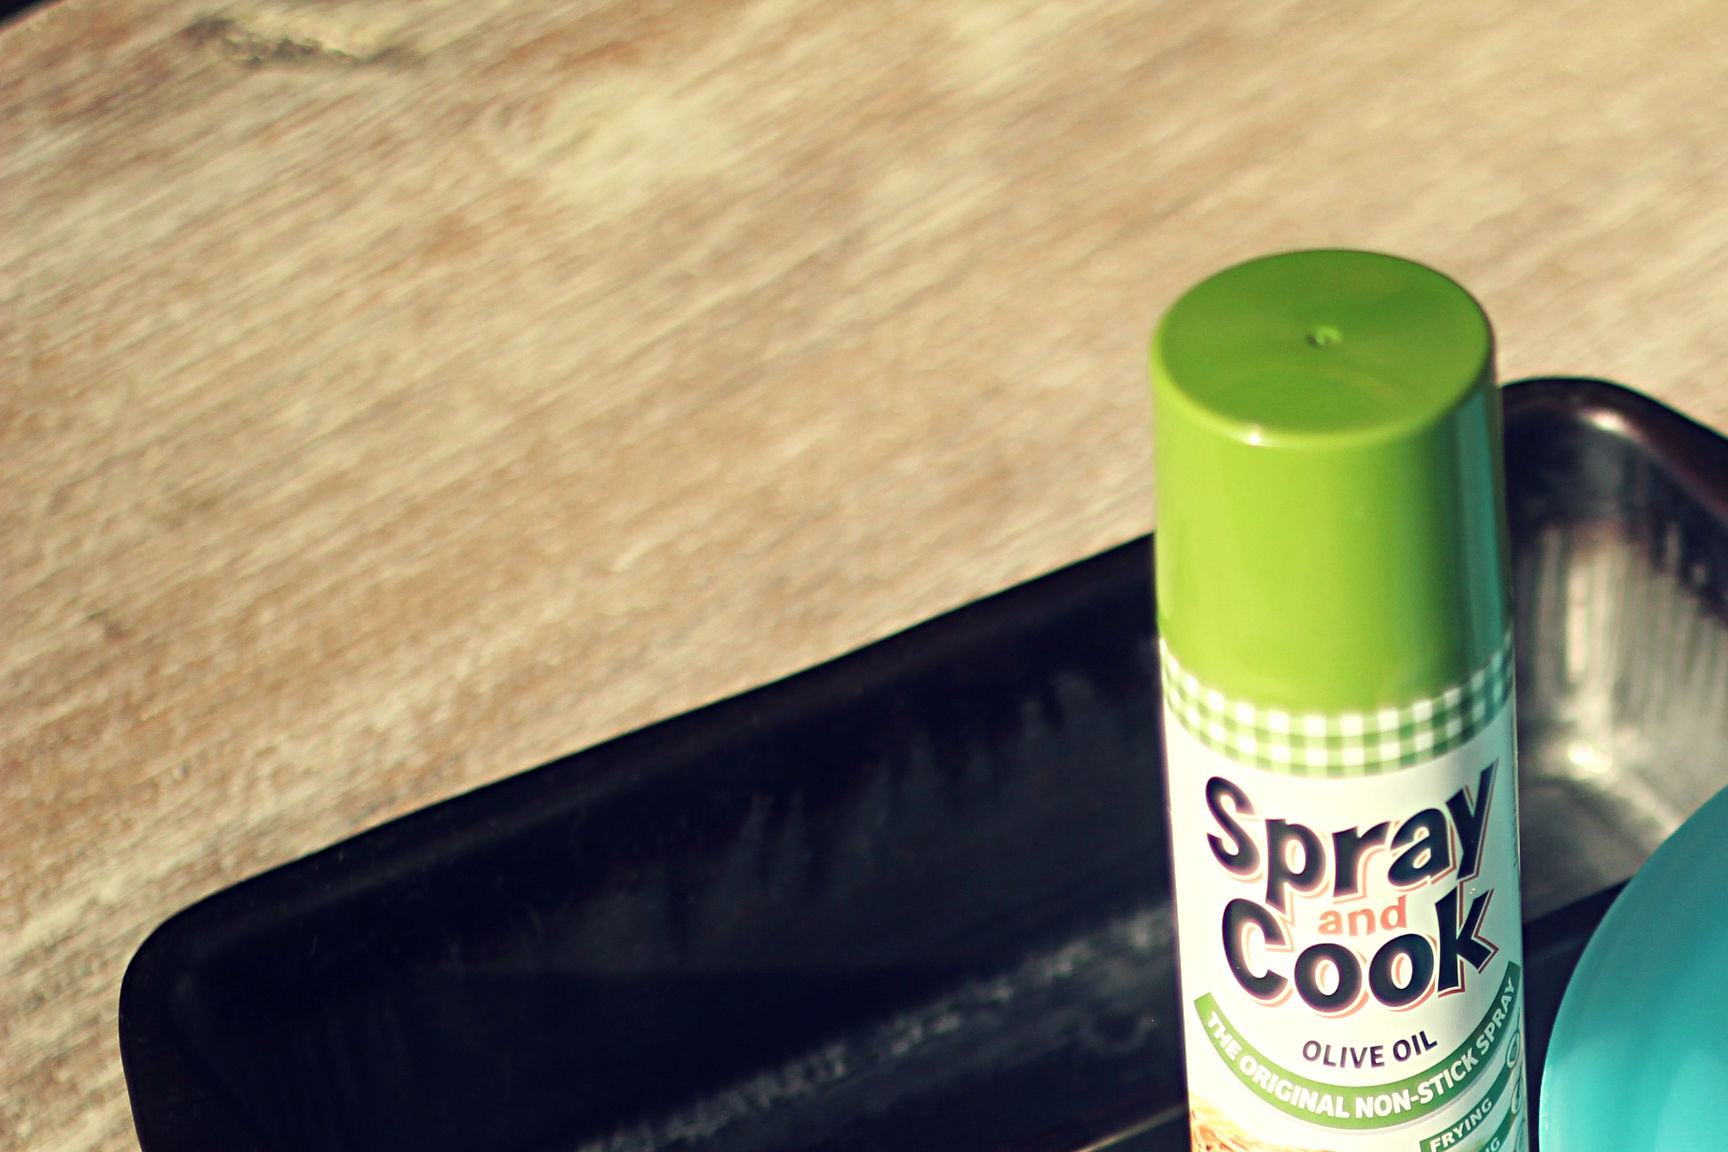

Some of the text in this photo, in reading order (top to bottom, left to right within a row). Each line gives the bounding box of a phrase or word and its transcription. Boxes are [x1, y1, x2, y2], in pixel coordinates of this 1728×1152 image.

[1205, 759, 1499, 925] Spray
[1221, 886, 1499, 1018] Cook
[1318, 894, 1407, 937] and
[1206, 977, 1516, 1119] THE ORIGINAL NON-STICK SPRAY
[1302, 1030, 1438, 1069] OLIVE OIL
